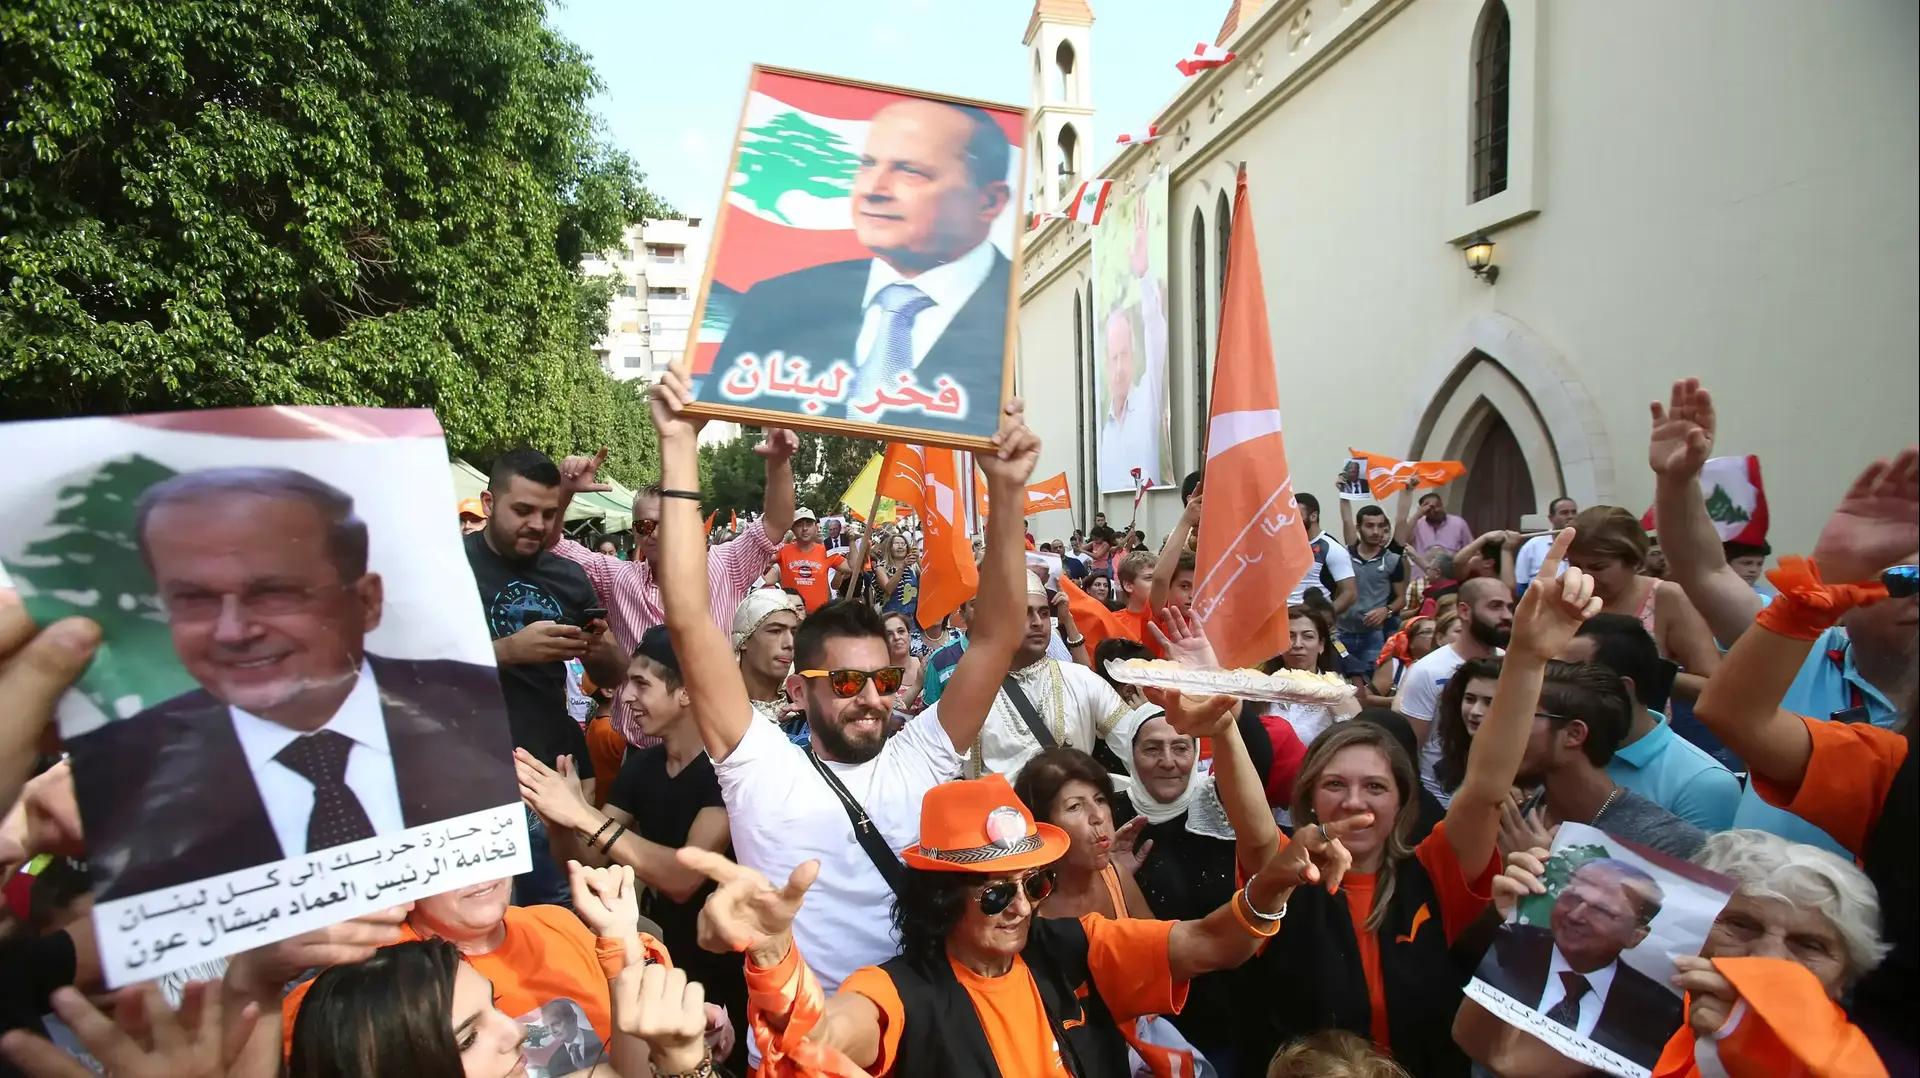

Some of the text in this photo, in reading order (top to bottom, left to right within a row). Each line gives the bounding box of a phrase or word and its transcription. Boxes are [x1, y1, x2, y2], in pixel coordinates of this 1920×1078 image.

[725, 356, 961, 415] فخر لبنان
[119, 816, 514, 931] من حارة حريك إلى كل لبنان
[125, 838, 518, 969] فخامة الرئيس العماد ميشال عون
